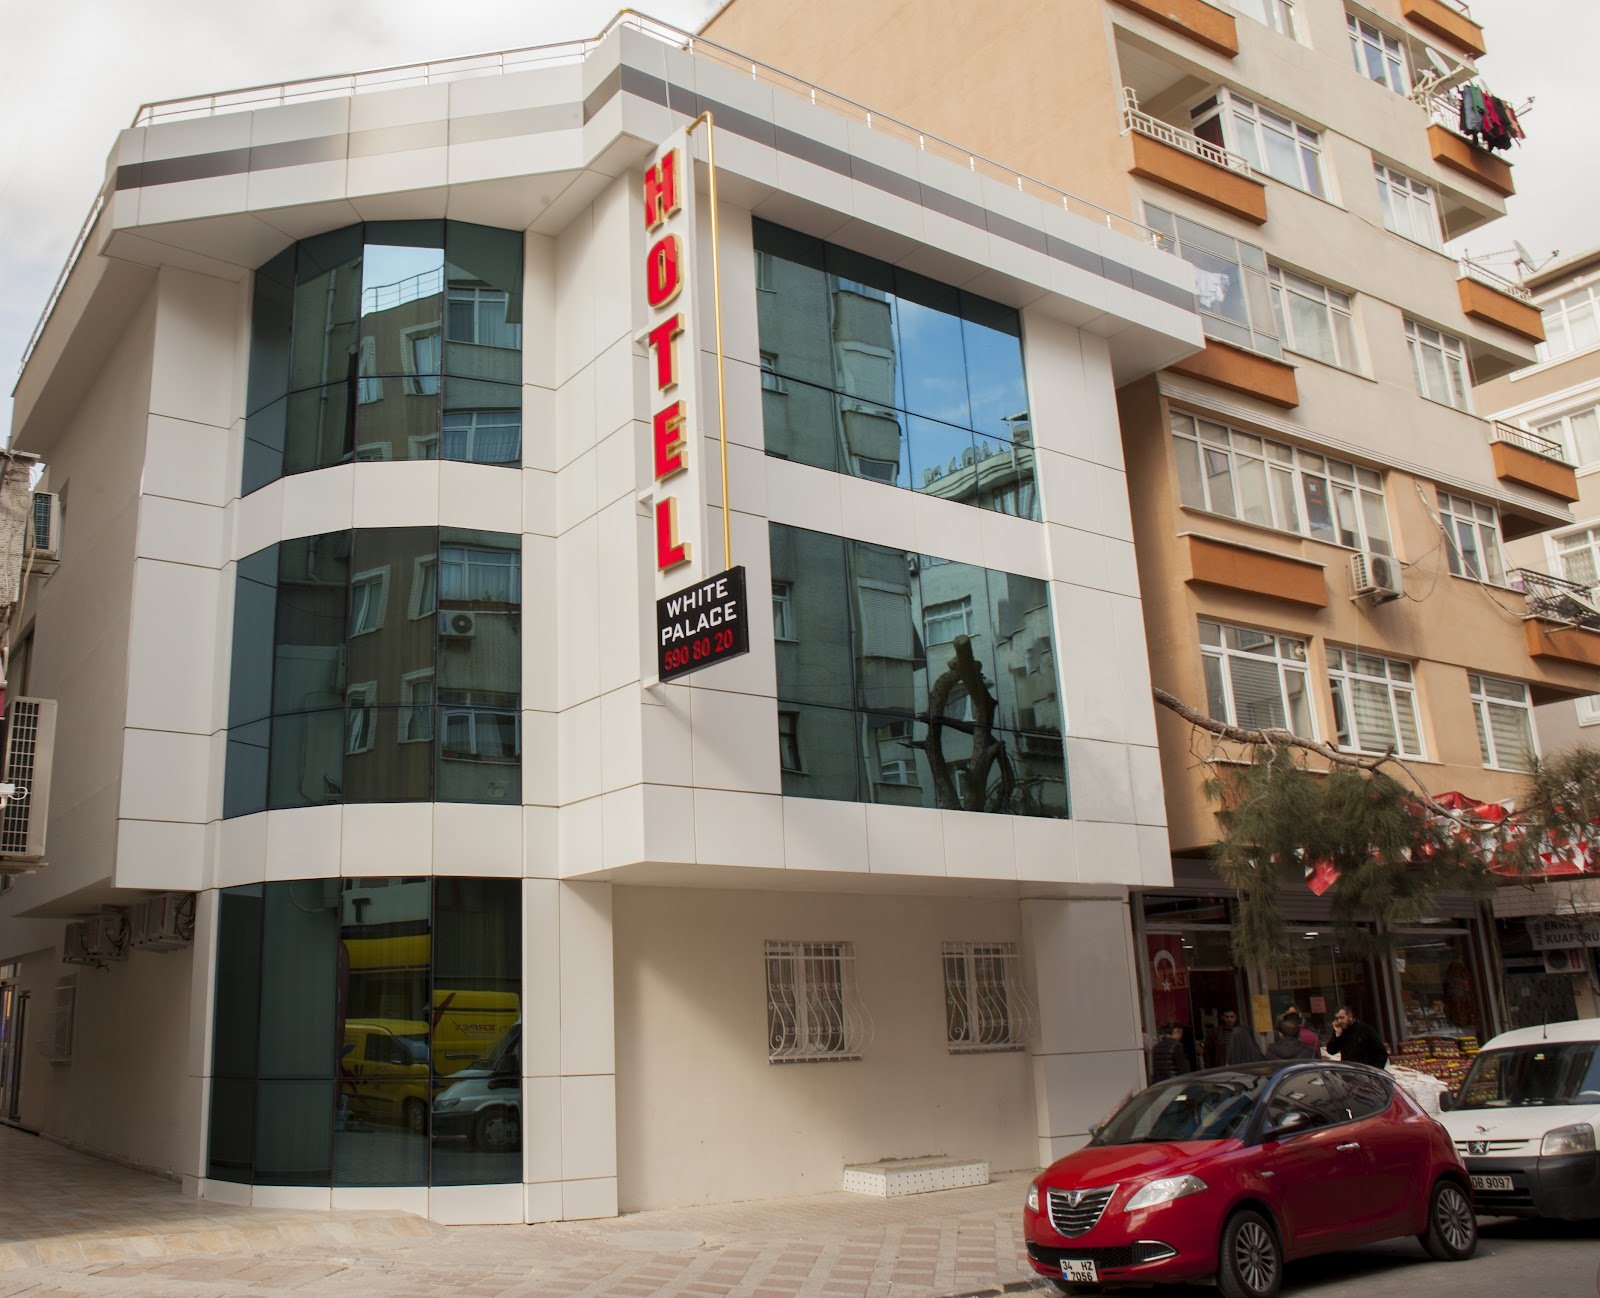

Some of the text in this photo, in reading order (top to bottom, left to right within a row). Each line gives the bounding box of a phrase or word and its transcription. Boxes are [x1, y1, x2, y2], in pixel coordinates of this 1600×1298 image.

[644, 147, 691, 573] HOTEL
[666, 577, 729, 618] WHITE
[661, 600, 737, 646] PALACE
[664, 628, 734, 671] 590 80 20
[1486, 1177, 1510, 1188] 9097
[1062, 1260, 1073, 1270] 34
[1070, 1271, 1093, 1281] 7056
